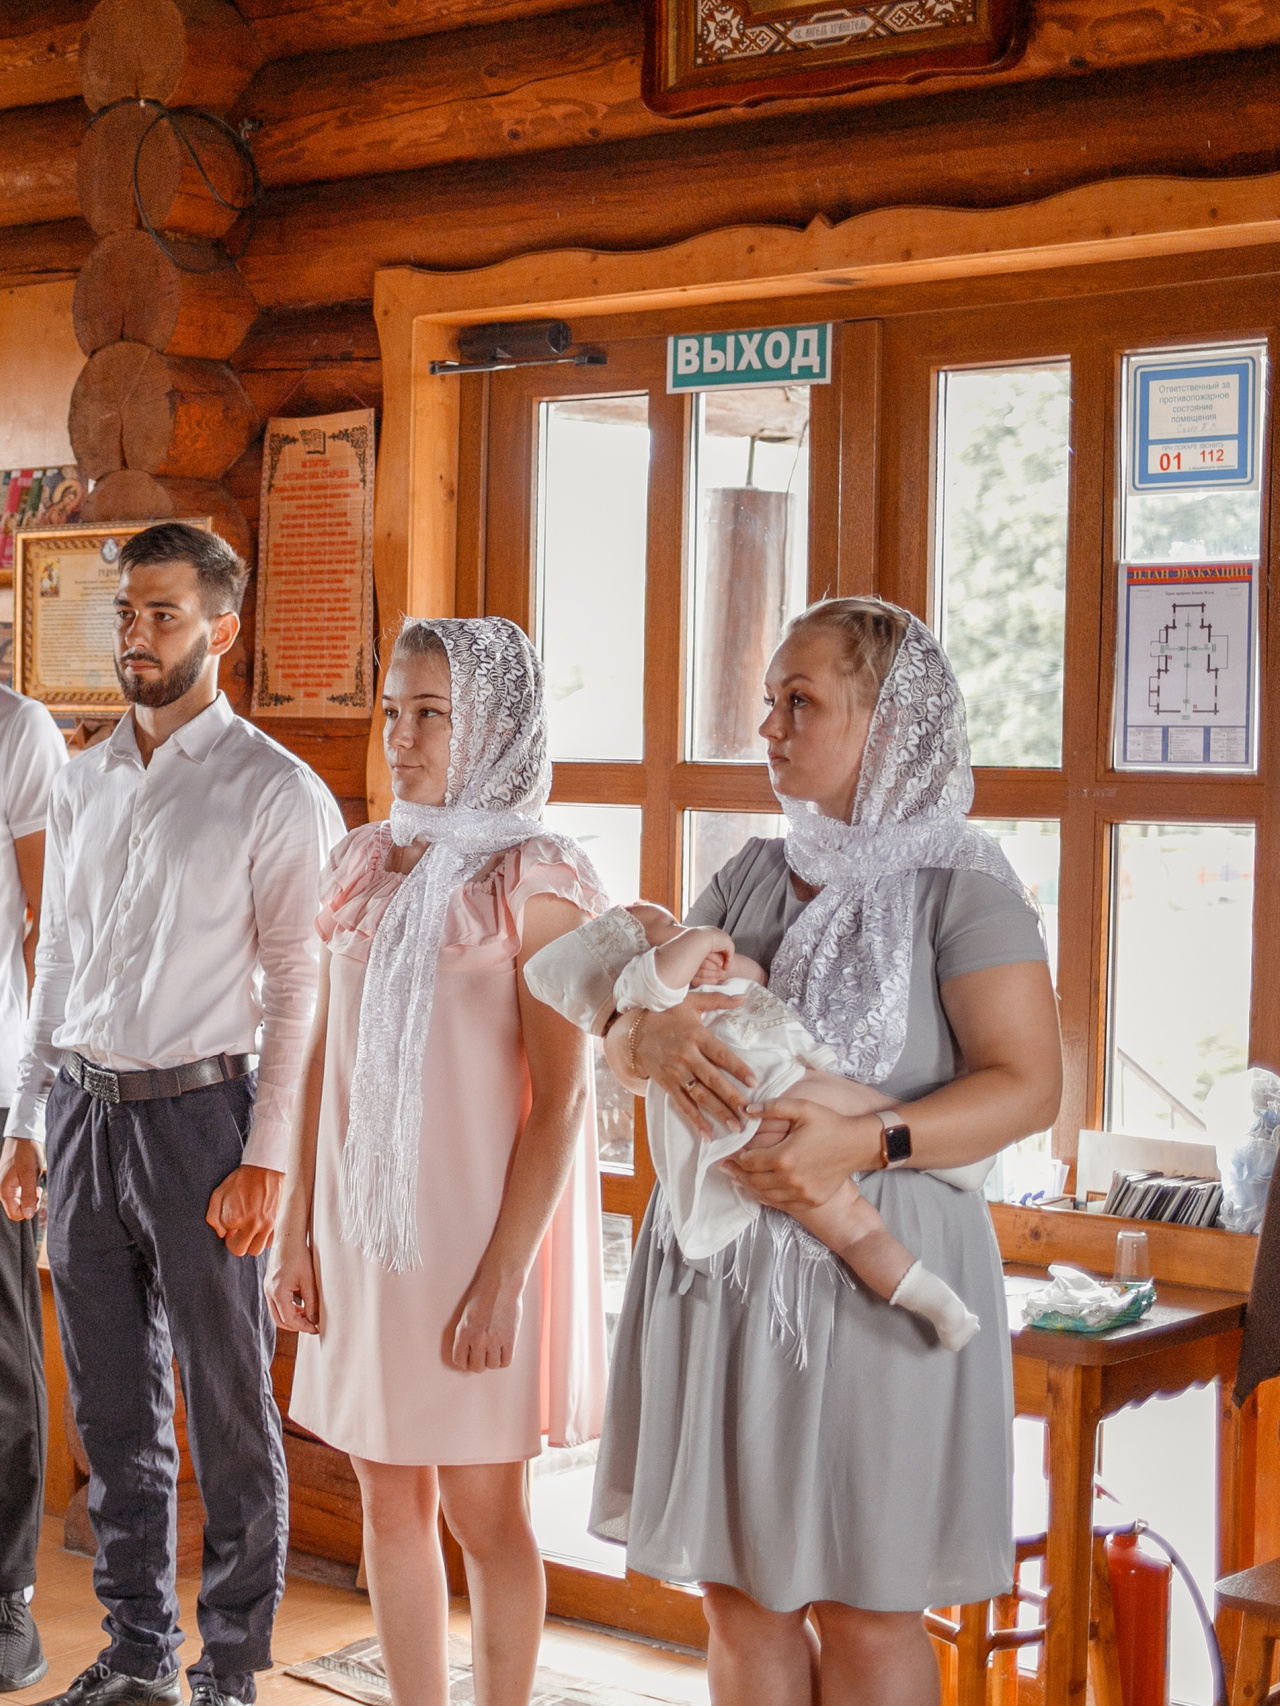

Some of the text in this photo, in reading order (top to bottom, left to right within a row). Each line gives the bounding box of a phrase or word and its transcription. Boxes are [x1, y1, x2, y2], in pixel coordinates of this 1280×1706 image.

[677, 328, 820, 375] ВЫХОД
[1158, 381, 1231, 394] Ответственный за
[1158, 392, 1230, 405] противопожарное
[1172, 403, 1214, 413] состояние
[1171, 413, 1217, 424] помещения
[1174, 443, 1197, 451] ПОЖАРЕ
[1199, 442, 1224, 450] ЗВОНИТЬ
[1159, 449, 1224, 471] 01 112
[1133, 566, 1248, 580] ПЛАН ЭВАКУАЦИИ
